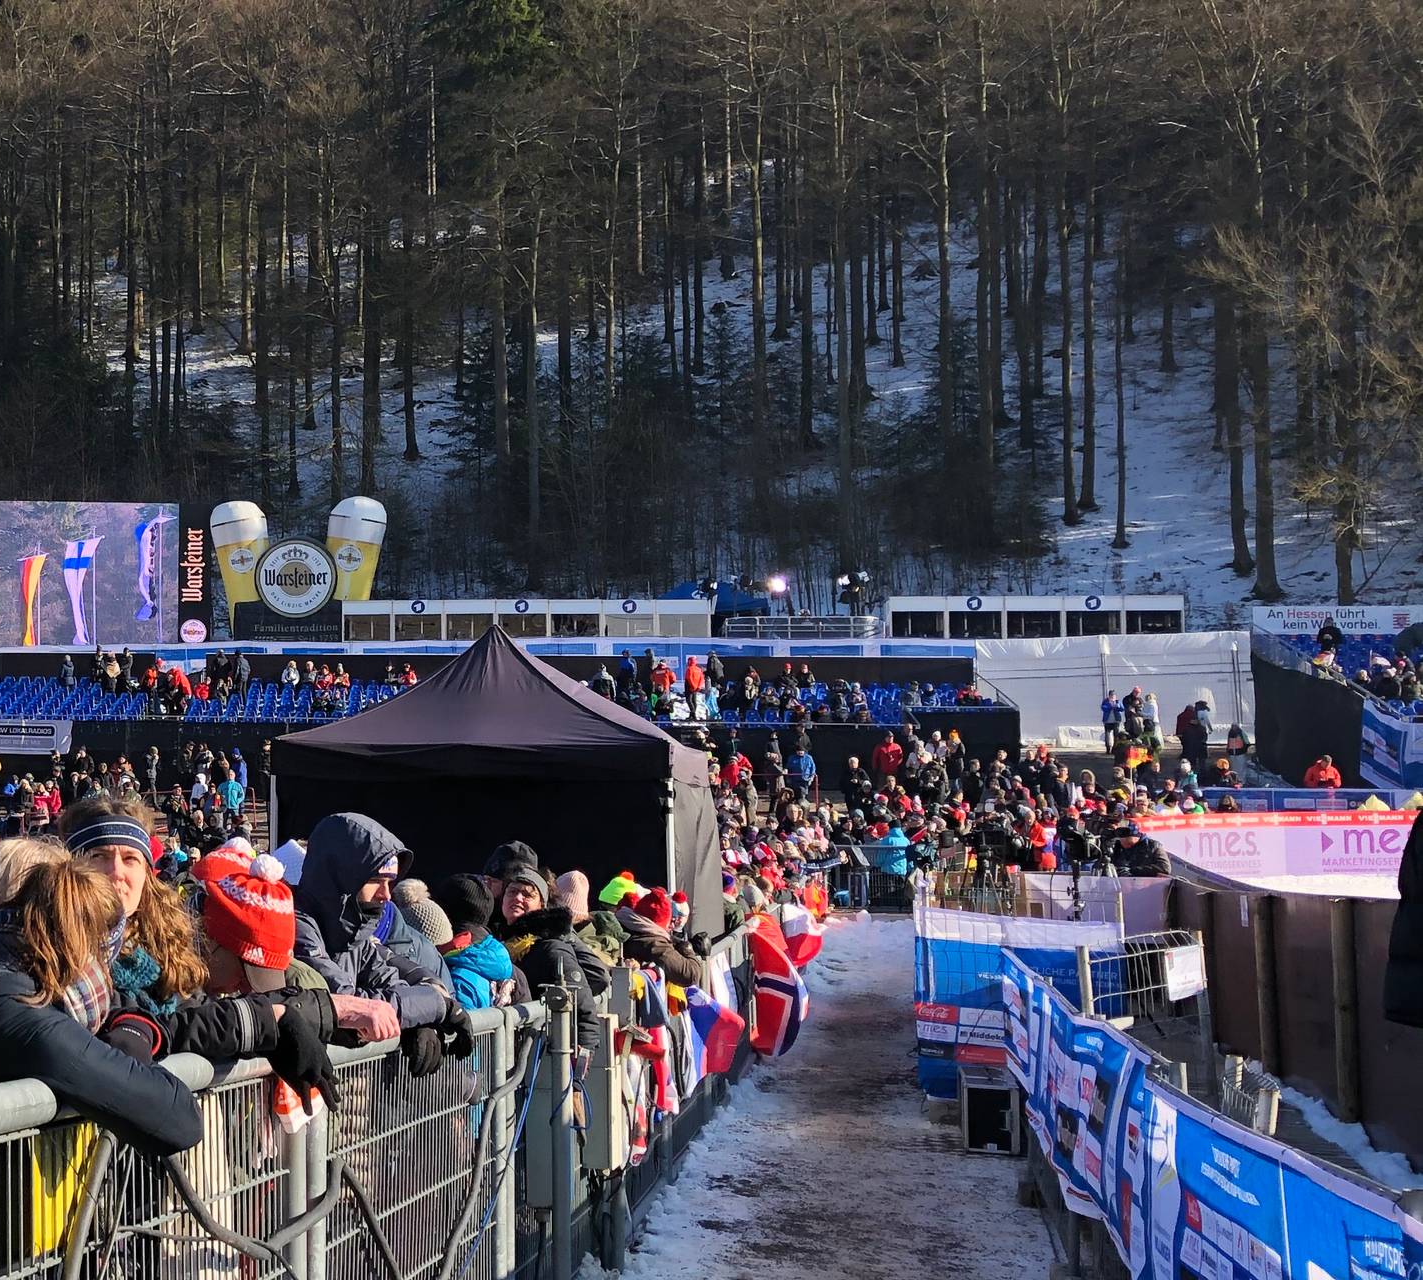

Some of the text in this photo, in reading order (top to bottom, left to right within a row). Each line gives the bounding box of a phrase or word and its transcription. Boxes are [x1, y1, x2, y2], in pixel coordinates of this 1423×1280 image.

[180, 527, 206, 603] Warsteiner
[264, 567, 328, 589] Warsteiner
[1267, 608, 1365, 619] An Hessen führt
[254, 622, 339, 633] Familientradition
[1283, 619, 1308, 630] kein
[1339, 619, 1381, 630] vorbei.
[9, 727, 52, 735] LOKALRADIOS
[1322, 857, 1401, 867] MARKETINGSER
